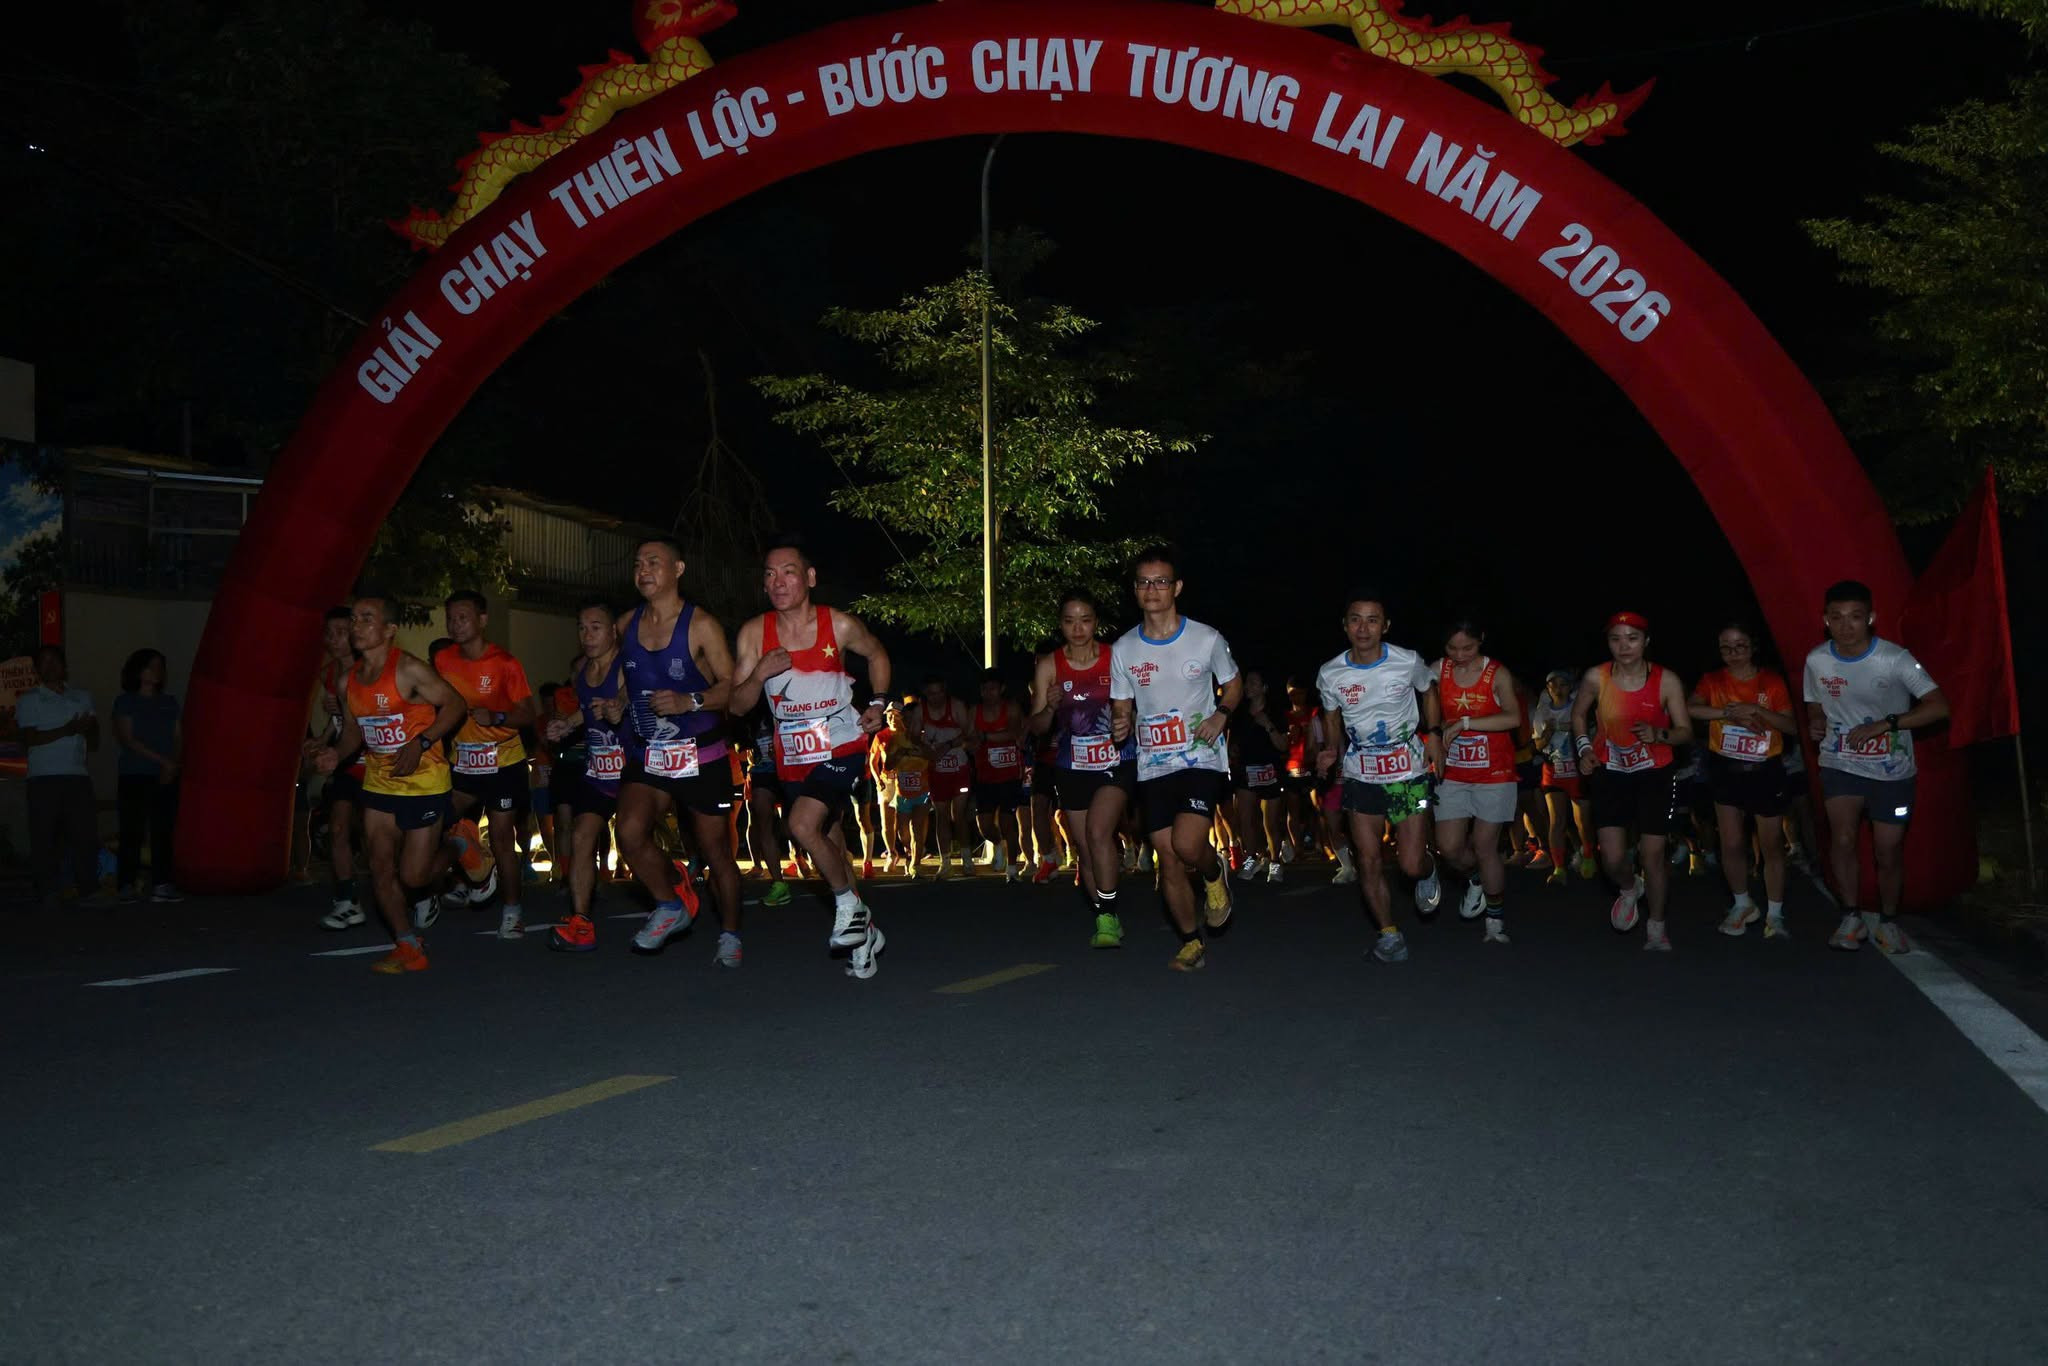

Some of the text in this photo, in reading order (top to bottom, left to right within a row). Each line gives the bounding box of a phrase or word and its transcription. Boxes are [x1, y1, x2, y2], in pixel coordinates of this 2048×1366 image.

[356, 33, 1671, 405] GIẢI CHẠY THIÊN LỘC - BƯỚC CHẠY TƯƠNG LAI NĂM 2026
[376, 726, 406, 744] 036
[793, 730, 828, 753] 001
[1152, 724, 1182, 744] 011
[469, 750, 497, 766] 008
[664, 750, 695, 769] 075
[1089, 744, 1116, 762] 168
[1460, 745, 1487, 760] 178
[1621, 747, 1649, 767] 134
[596, 756, 624, 771] 080
[1378, 755, 1408, 773] 130
